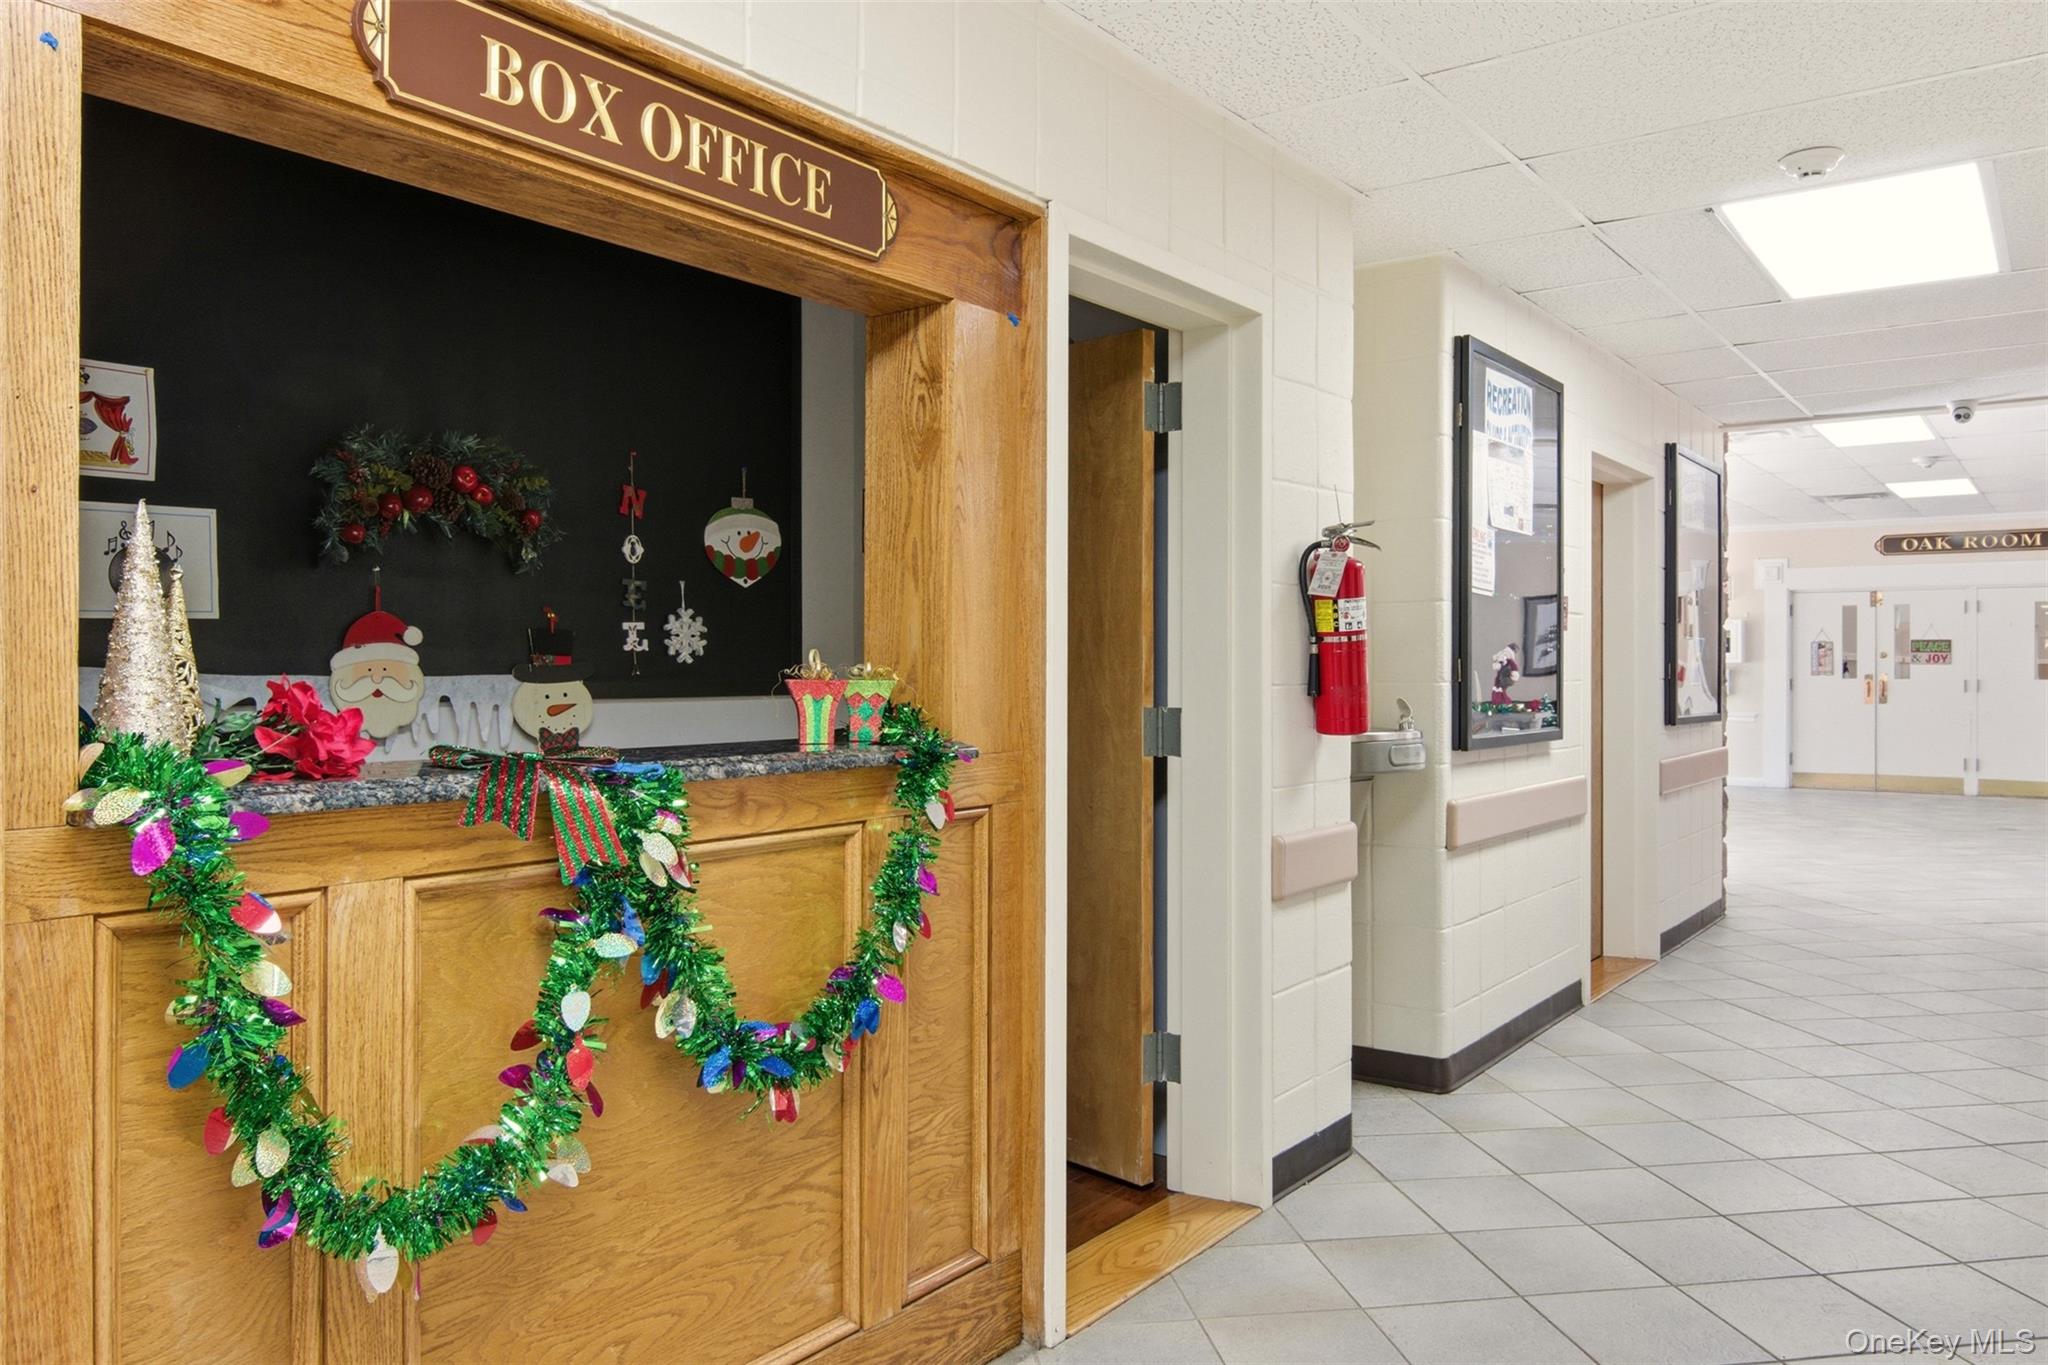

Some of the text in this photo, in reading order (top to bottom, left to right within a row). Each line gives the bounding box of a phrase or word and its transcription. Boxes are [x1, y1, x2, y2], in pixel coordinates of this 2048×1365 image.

[480, 34, 833, 219] BOX OFFICE
[1487, 379, 1532, 422] RECREATION
[1901, 532, 2043, 551] OAK ROOM
[1911, 640, 1951, 652] PEACE
[1925, 653, 1949, 663] JOY
